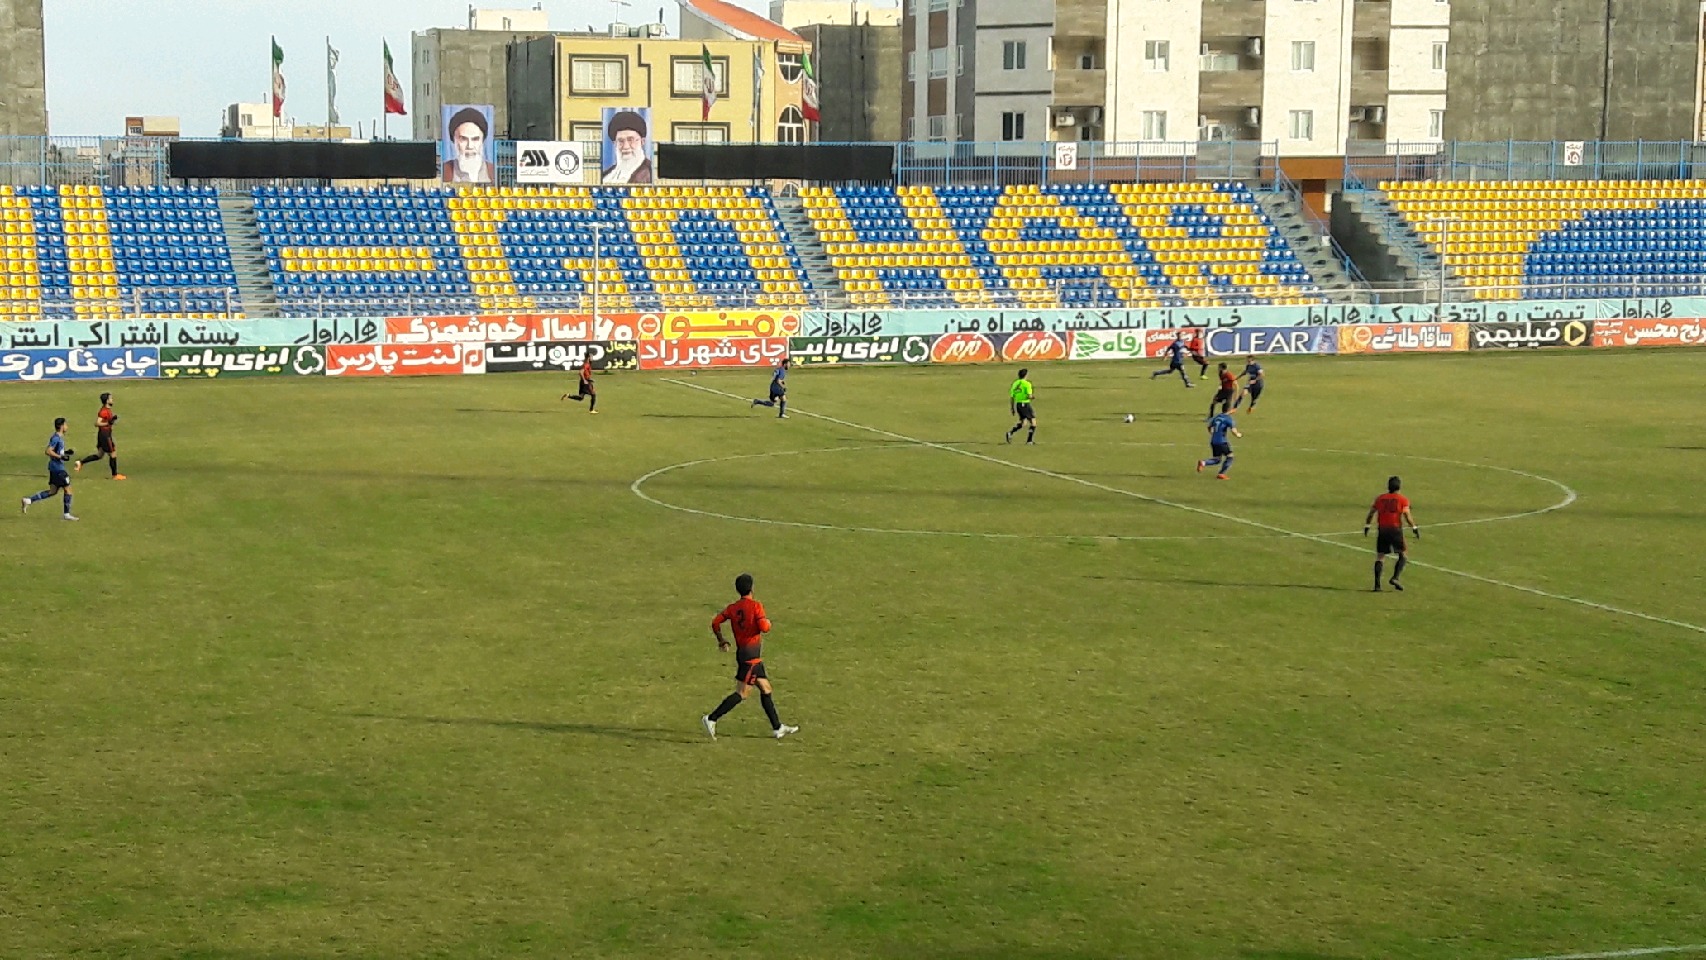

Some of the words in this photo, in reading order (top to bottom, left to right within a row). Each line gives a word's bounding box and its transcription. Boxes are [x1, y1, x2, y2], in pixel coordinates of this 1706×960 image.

[177, 326, 240, 346] بسته
[530, 317, 587, 341] سال
[671, 312, 776, 341] مینو
[1475, 321, 1561, 347] فیلیمو
[1623, 322, 1679, 346] محسن
[401, 343, 464, 366] لنت
[640, 339, 738, 366] شهرزاد
[739, 339, 786, 366] چای
[1103, 330, 1142, 356] رفاه
[1206, 328, 1310, 355] CLEAR
[101, 350, 157, 376] چای
[327, 345, 398, 375] پارس
